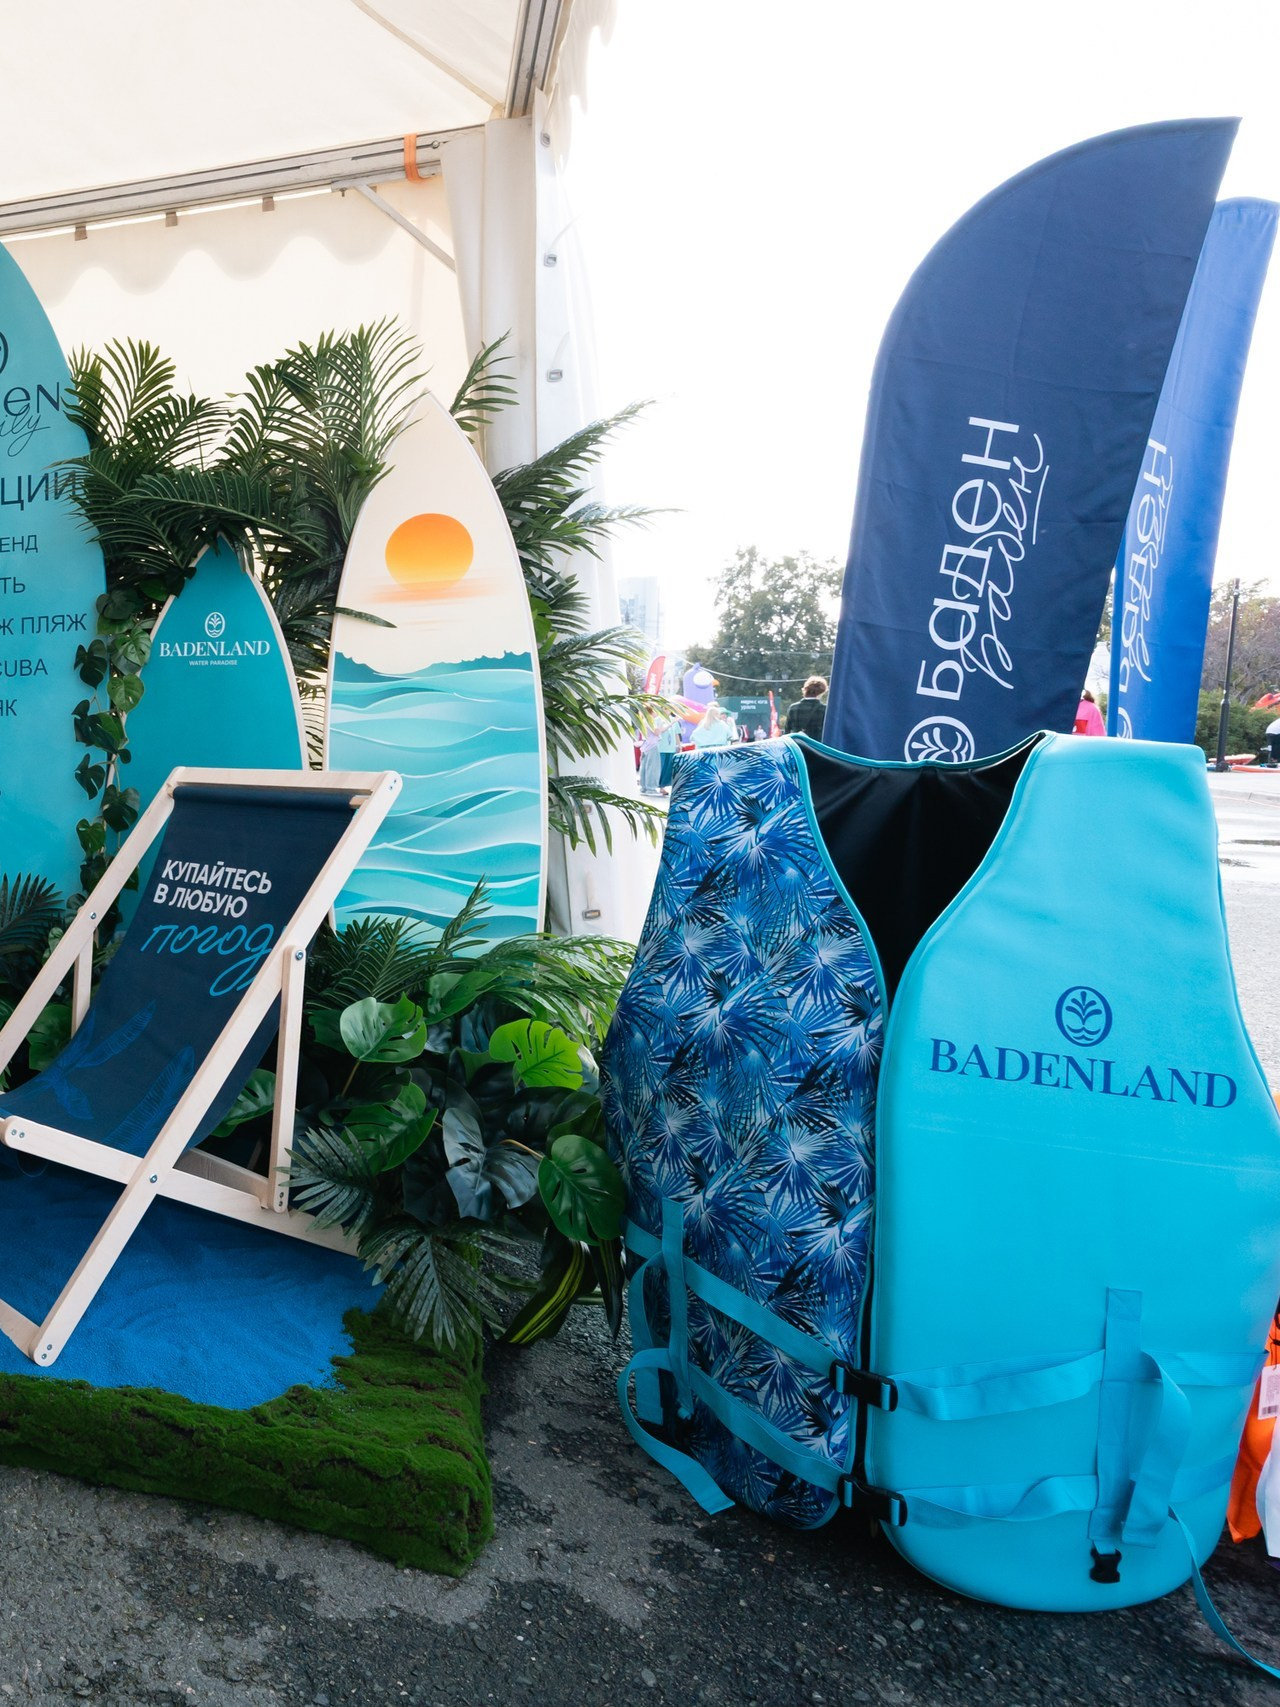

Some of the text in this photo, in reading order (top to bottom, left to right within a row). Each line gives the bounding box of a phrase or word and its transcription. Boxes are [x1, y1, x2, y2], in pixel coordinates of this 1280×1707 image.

[21, 613, 88, 635] ПЛЯЖ
[160, 640, 270, 657] BADENLAND
[161, 859, 272, 894] КУПАЙТЕСЬ
[153, 883, 248, 918] В ЛЮБУЮ
[140, 923, 280, 997] погод
[929, 1037, 1238, 1109] BADENLAND
